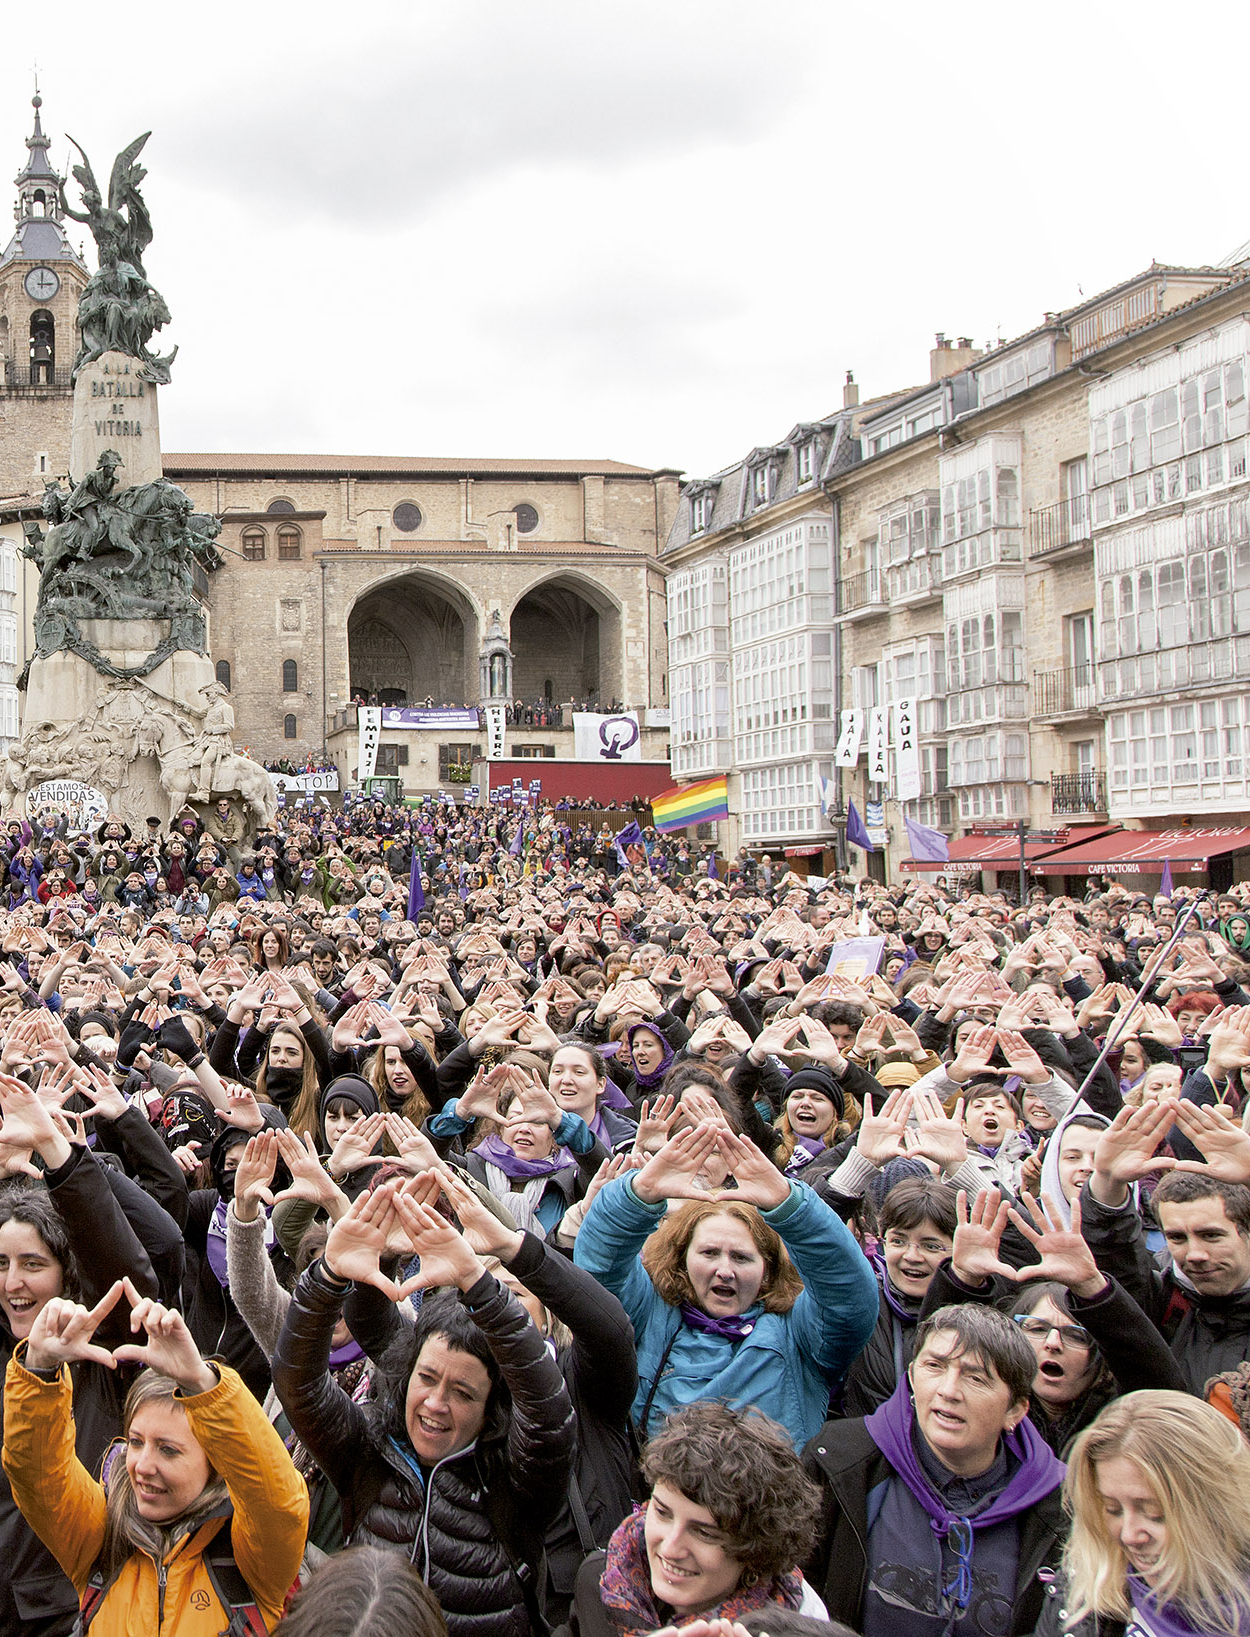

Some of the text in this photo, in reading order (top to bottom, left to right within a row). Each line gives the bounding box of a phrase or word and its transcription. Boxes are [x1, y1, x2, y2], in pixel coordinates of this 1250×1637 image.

[103, 364, 130, 375] A LA
[92, 381, 145, 397] BATALLA
[112, 403, 124, 414] DE
[95, 420, 142, 436] VITORIA
[900, 701, 912, 751] GAUA
[843, 714, 854, 758] JAIA
[875, 713, 884, 773] KALEA
[40, 783, 84, 791] ESTAMOS
[31, 790, 95, 801] VENDIDAS
[957, 863, 983, 872] VICTORIA
[1106, 864, 1141, 874] VICTORIA
